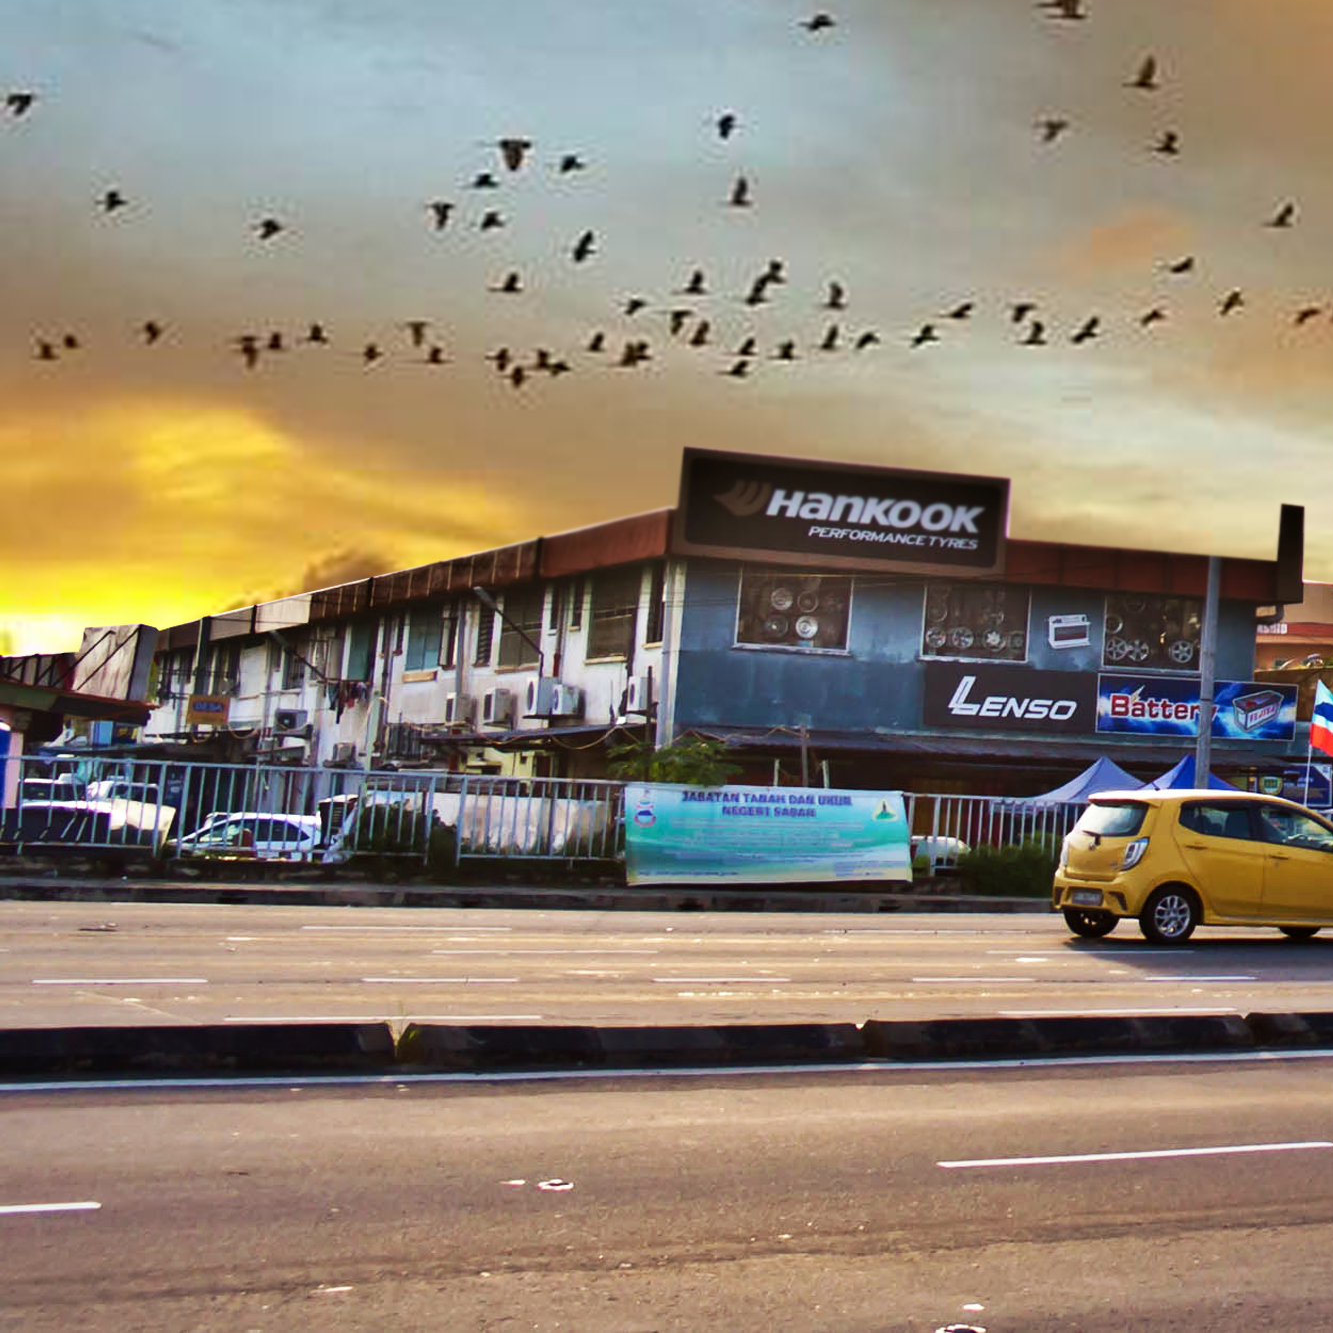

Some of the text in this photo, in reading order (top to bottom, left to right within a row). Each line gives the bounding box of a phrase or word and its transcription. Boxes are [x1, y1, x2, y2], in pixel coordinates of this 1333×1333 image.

[808, 526, 979, 550] PERFORMANCE TYRES
[948, 676, 1077, 720] LENSO
